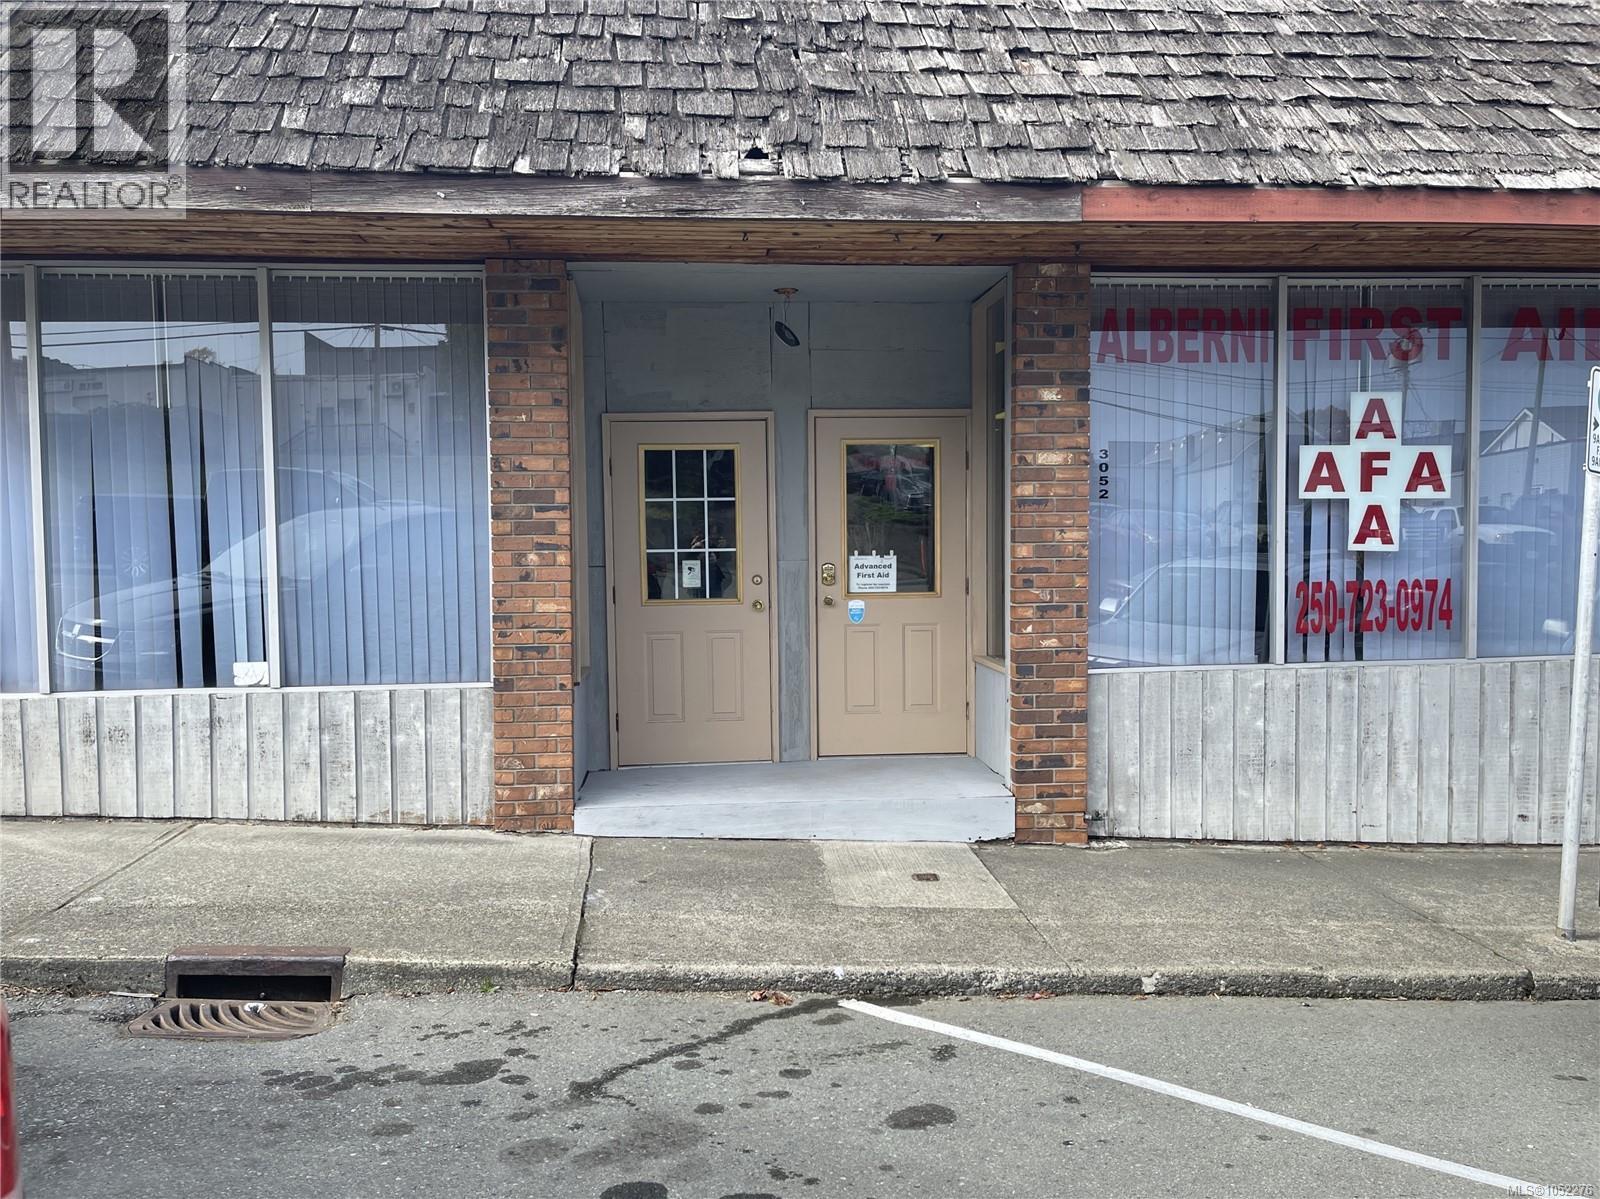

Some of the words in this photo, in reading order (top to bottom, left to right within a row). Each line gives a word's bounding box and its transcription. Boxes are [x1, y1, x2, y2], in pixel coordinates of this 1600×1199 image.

[1096, 307, 1270, 364] ALBERNI
[1292, 307, 1463, 362] FIRST
[1098, 448, 1110, 500] 3052
[854, 562, 893, 570] Advanced
[1295, 577, 1454, 635] 250-723-0974
